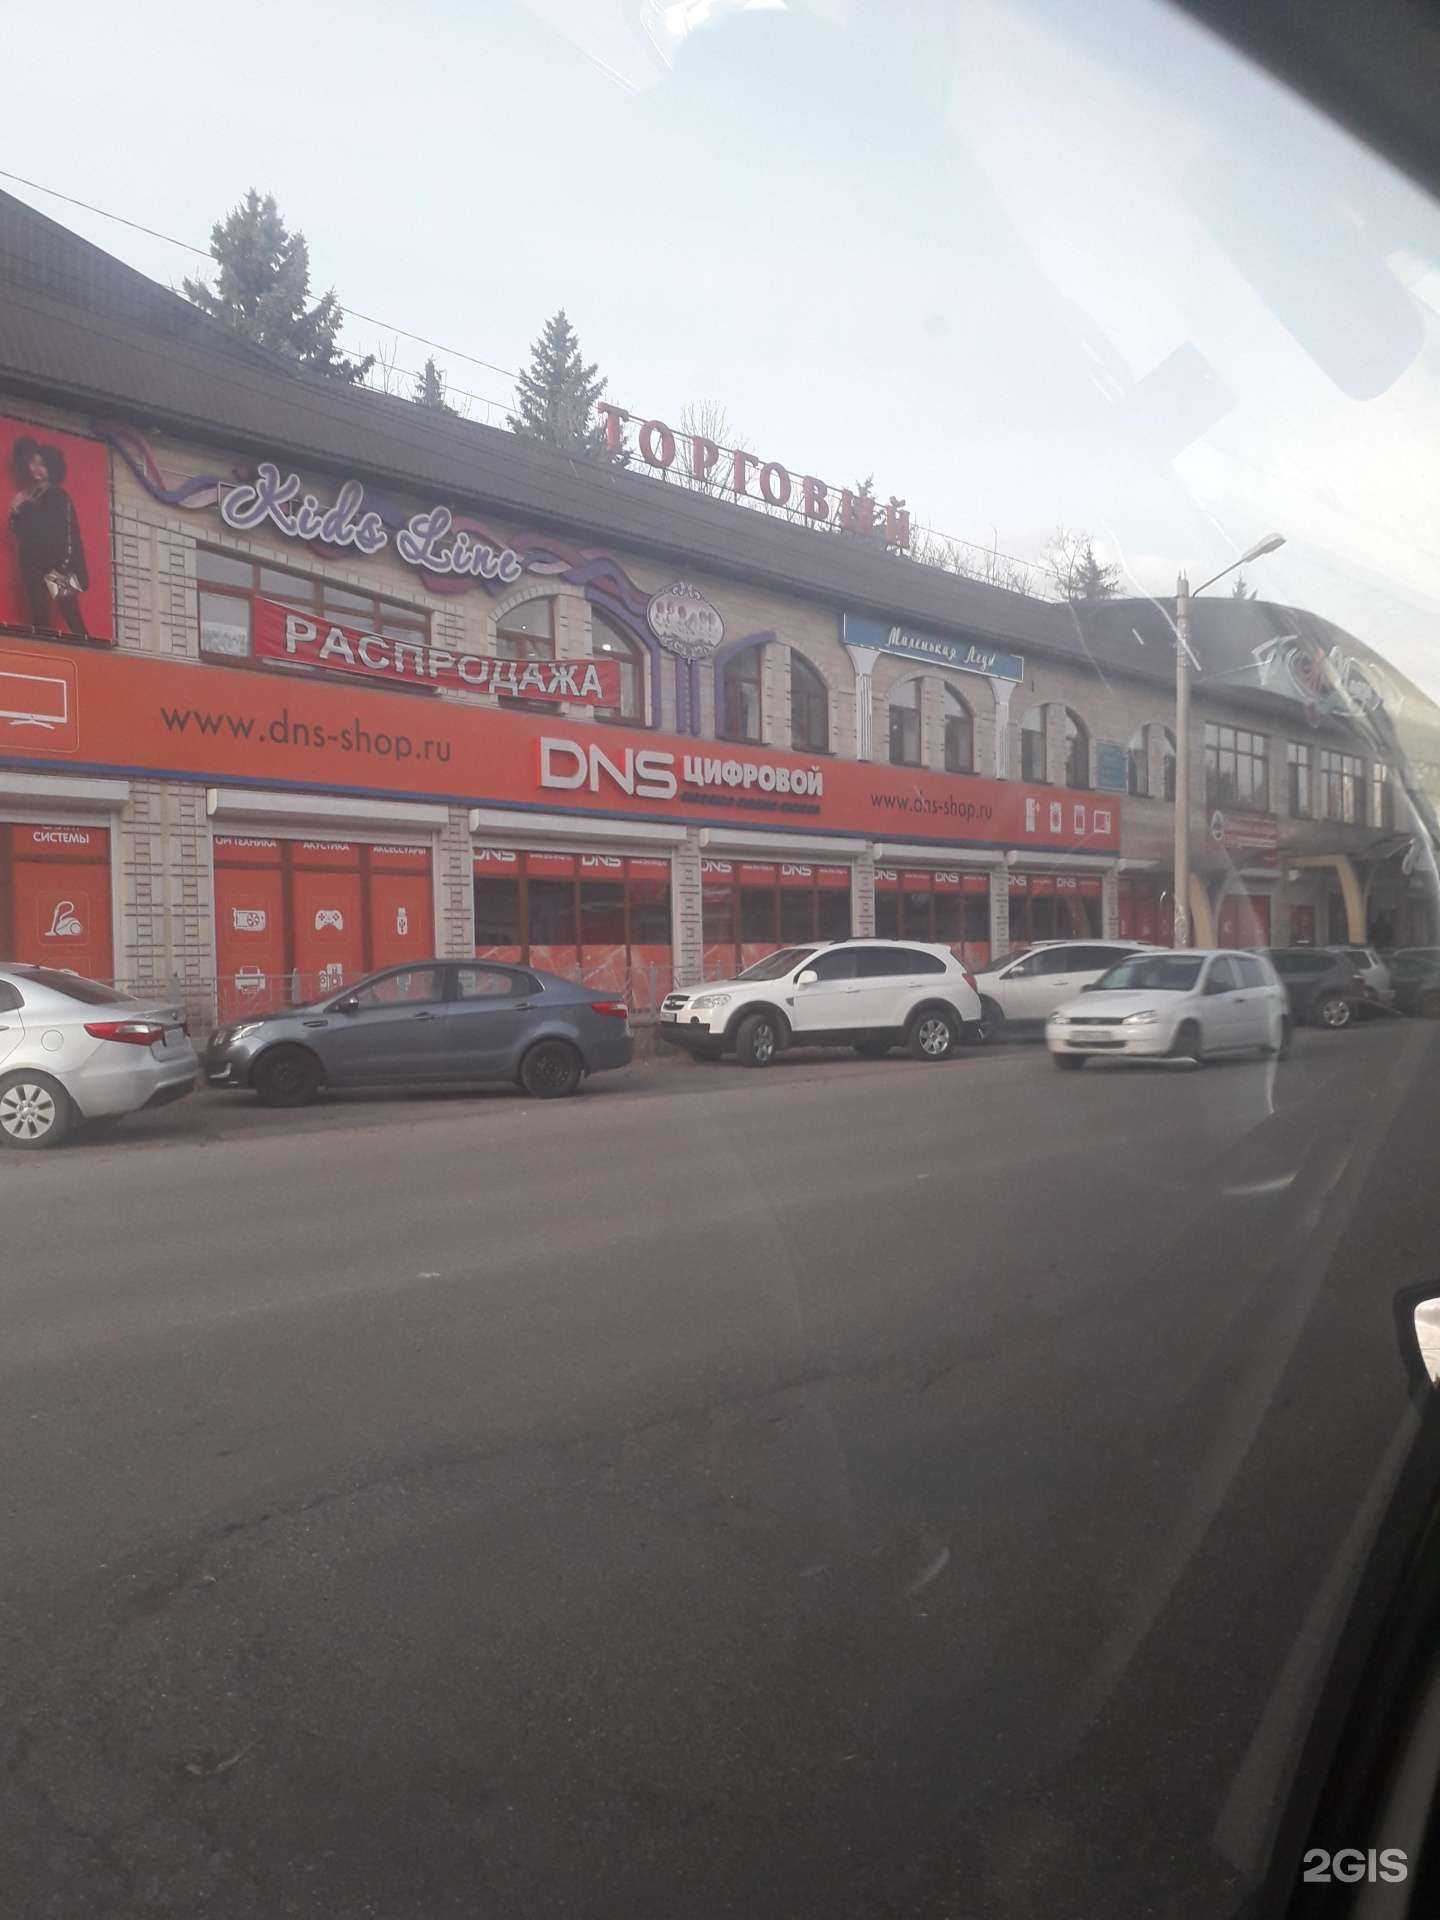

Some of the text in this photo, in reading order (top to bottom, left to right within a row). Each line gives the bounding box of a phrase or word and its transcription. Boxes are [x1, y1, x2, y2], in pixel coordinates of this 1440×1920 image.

[597, 401, 910, 549] ТОРГОВЫЙ
[221, 462, 522, 582] Kids Line
[285, 614, 603, 698] РАСПРОДАЖА
[160, 707, 452, 763] www.dns-shop.ru
[539, 737, 824, 800] DNS ЦИФРОВОЙ
[871, 789, 993, 822] www.dns-shop.ru
[33, 831, 90, 844] СИСТЕМЫ
[581, 854, 622, 868] DNS
[782, 864, 812, 876] DNS
[935, 872, 959, 883] DNS
